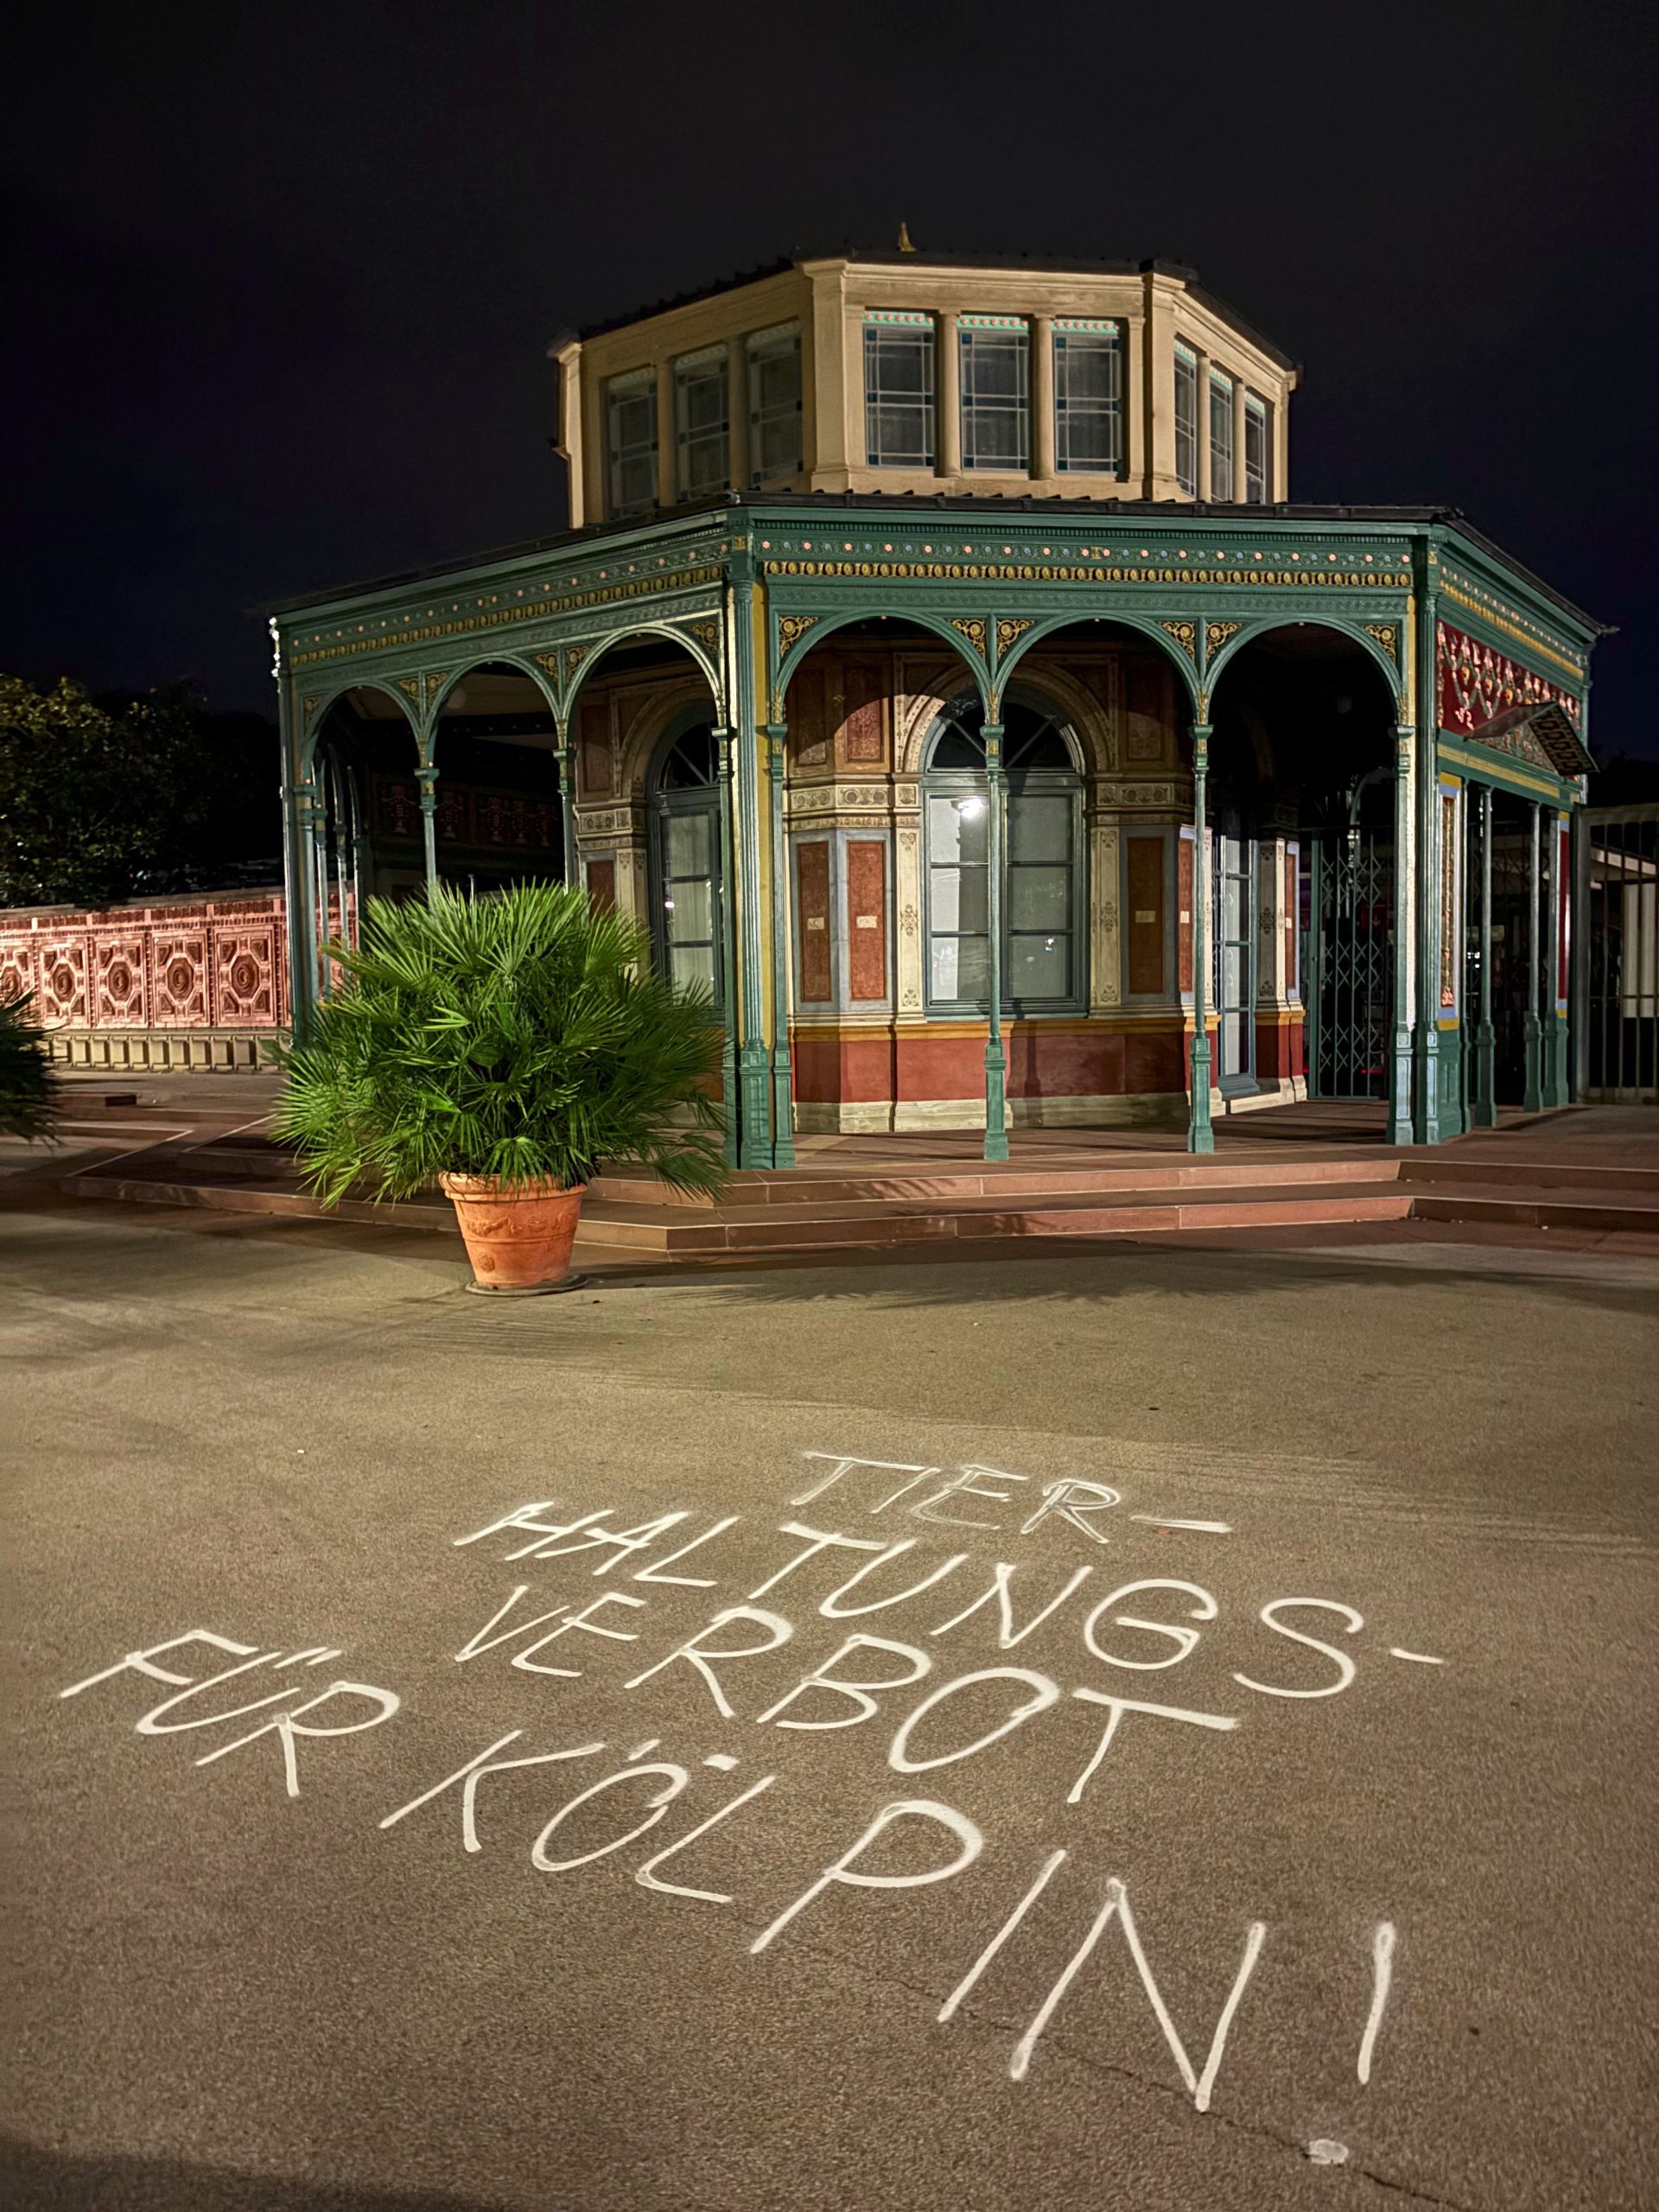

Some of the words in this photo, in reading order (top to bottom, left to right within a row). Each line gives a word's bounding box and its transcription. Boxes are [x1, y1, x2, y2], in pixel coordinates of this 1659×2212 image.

[787, 1449, 1233, 1544] TIER-
[452, 1499, 1446, 1700] HALTUNGS-
[59, 1629, 402, 1797] FÜR
[454, 1583, 1241, 1804] VERBOT
